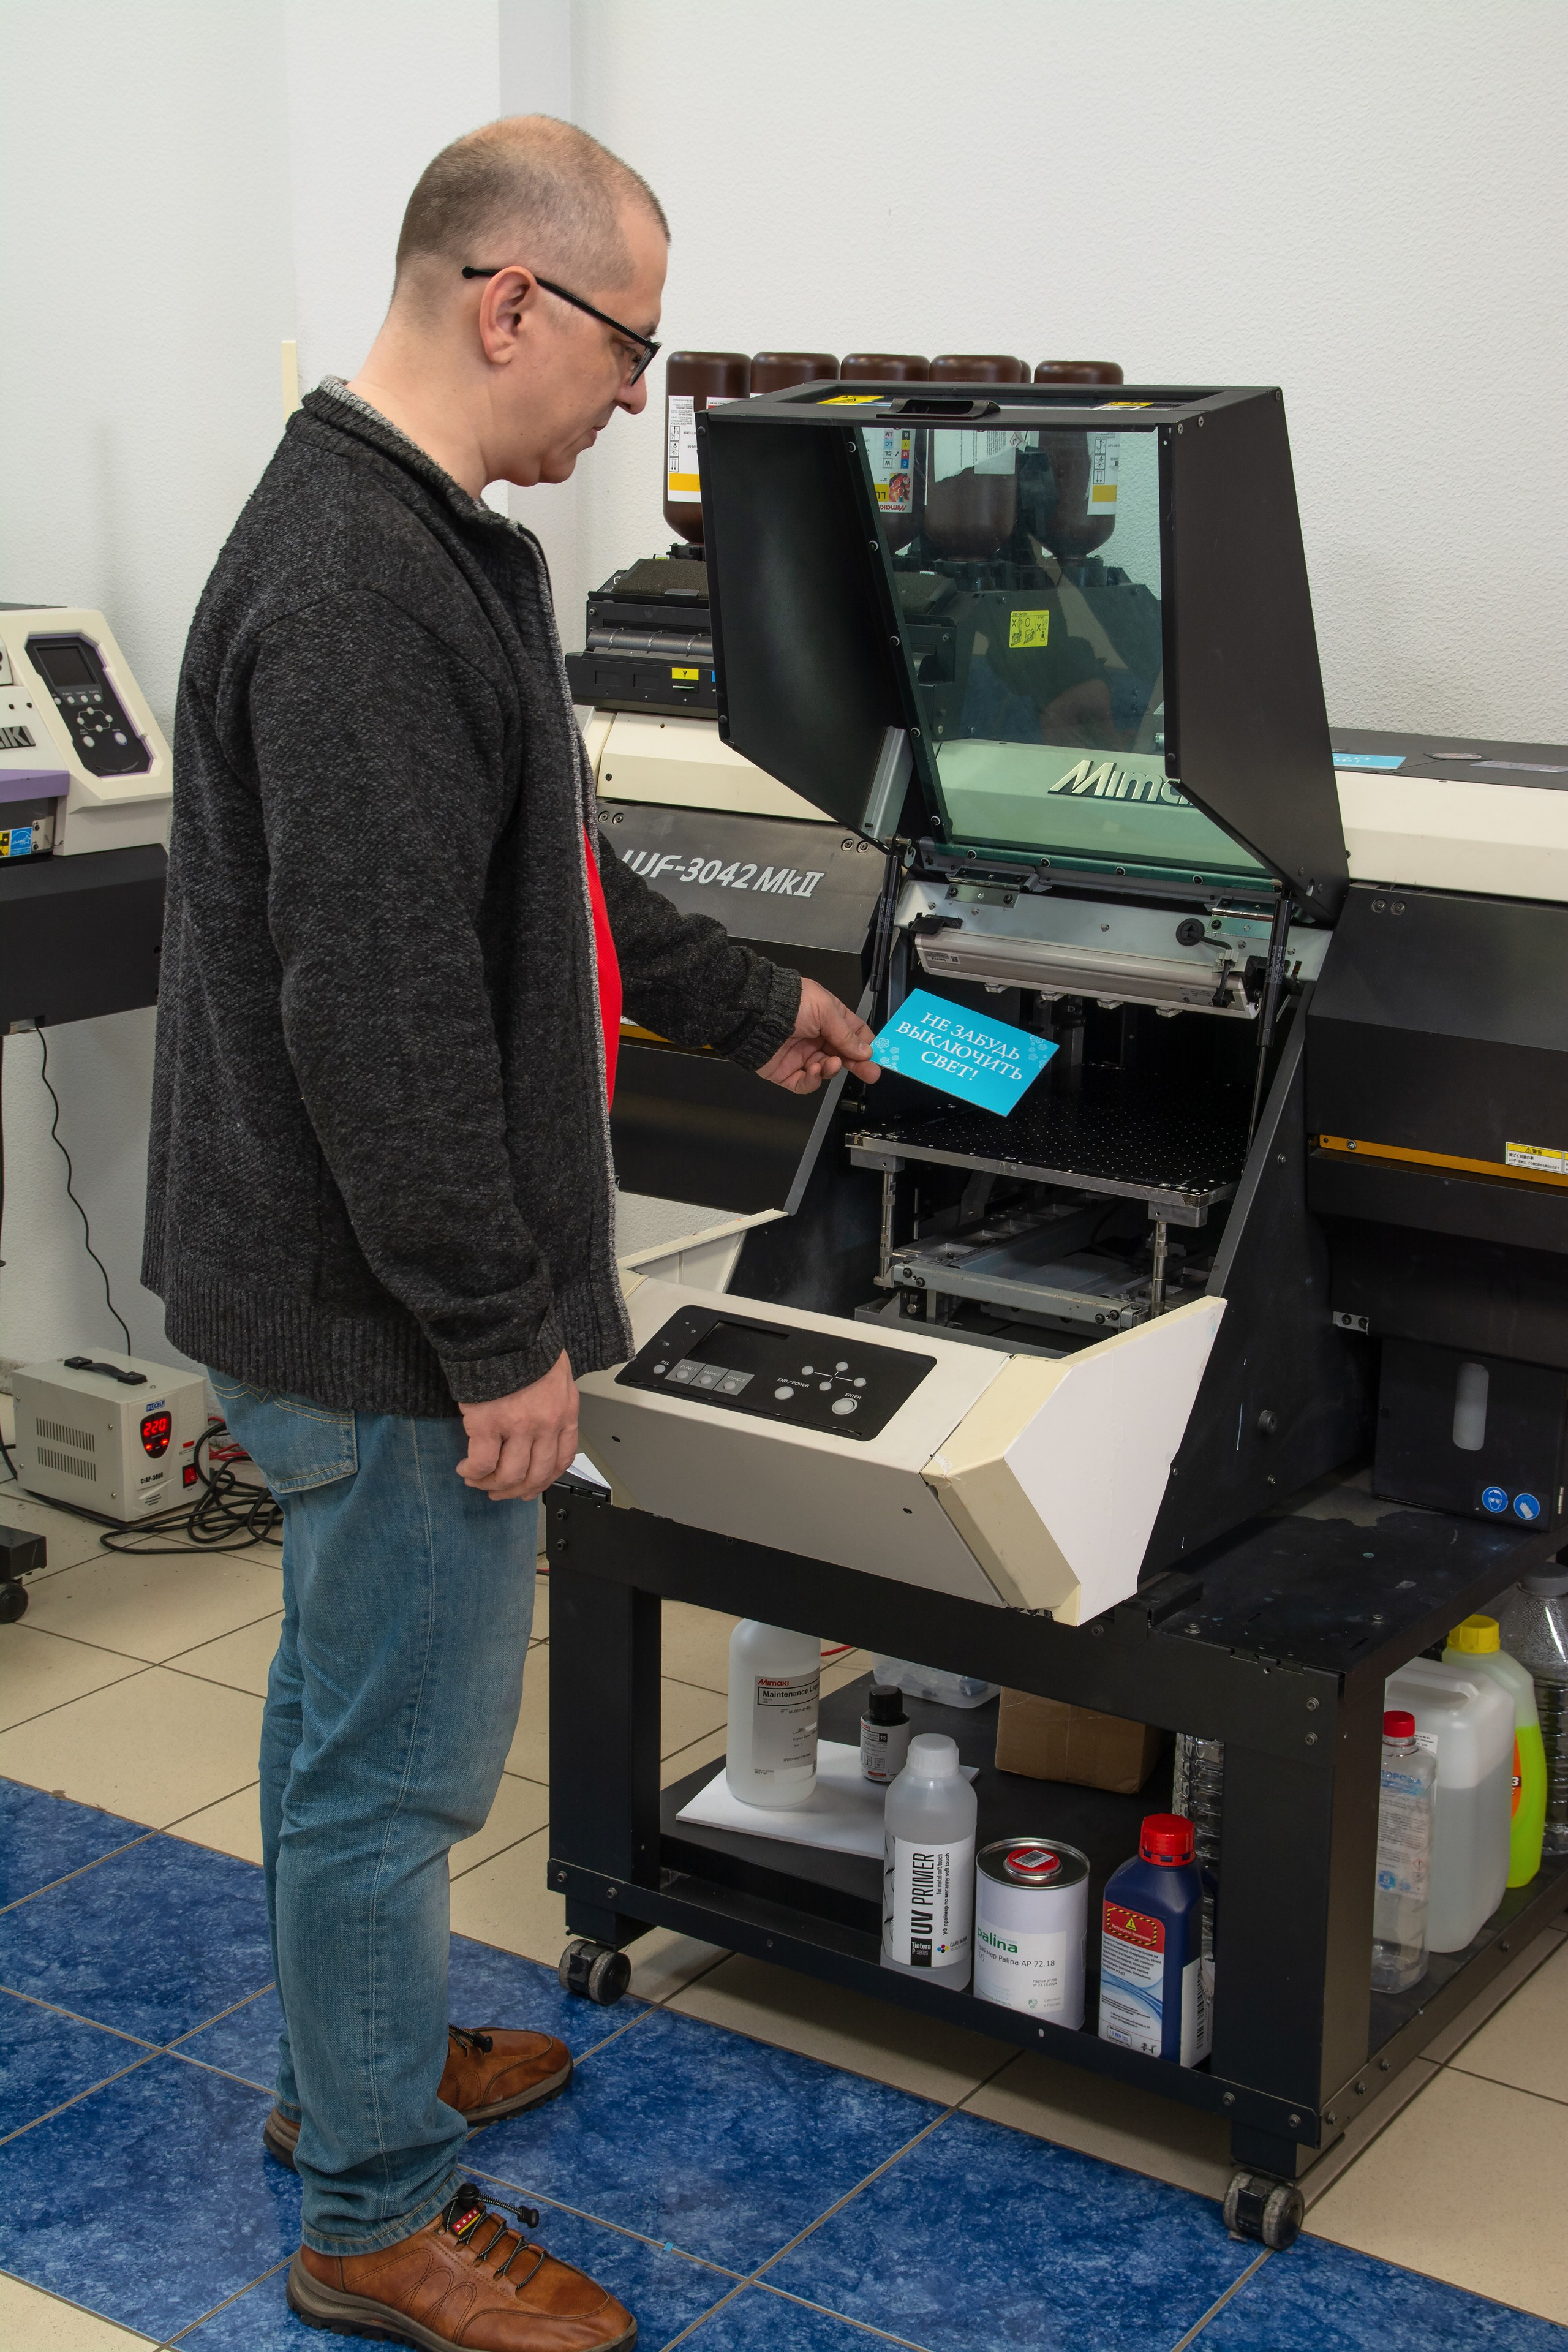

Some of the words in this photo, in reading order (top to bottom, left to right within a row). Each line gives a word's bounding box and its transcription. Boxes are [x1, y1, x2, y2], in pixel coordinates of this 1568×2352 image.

[920, 1012, 951, 1031] НЕ
[951, 1025, 1020, 1060] ЗАБУДЬ
[895, 1021, 1022, 1080] ВЫКЛЮЧИТЬ
[921, 1051, 979, 1081] СВЕТ!
[146, 1400, 165, 1411] RUCELF
[143, 1417, 168, 1437] 220
[763, 1688, 808, 1698] Maintenance
[911, 1853, 935, 1905] PRIMER
[911, 1909, 933, 1935] UV
[943, 1927, 948, 1936] УФ
[977, 1926, 1018, 1953] palina
[998, 1954, 1019, 1966] Palina
